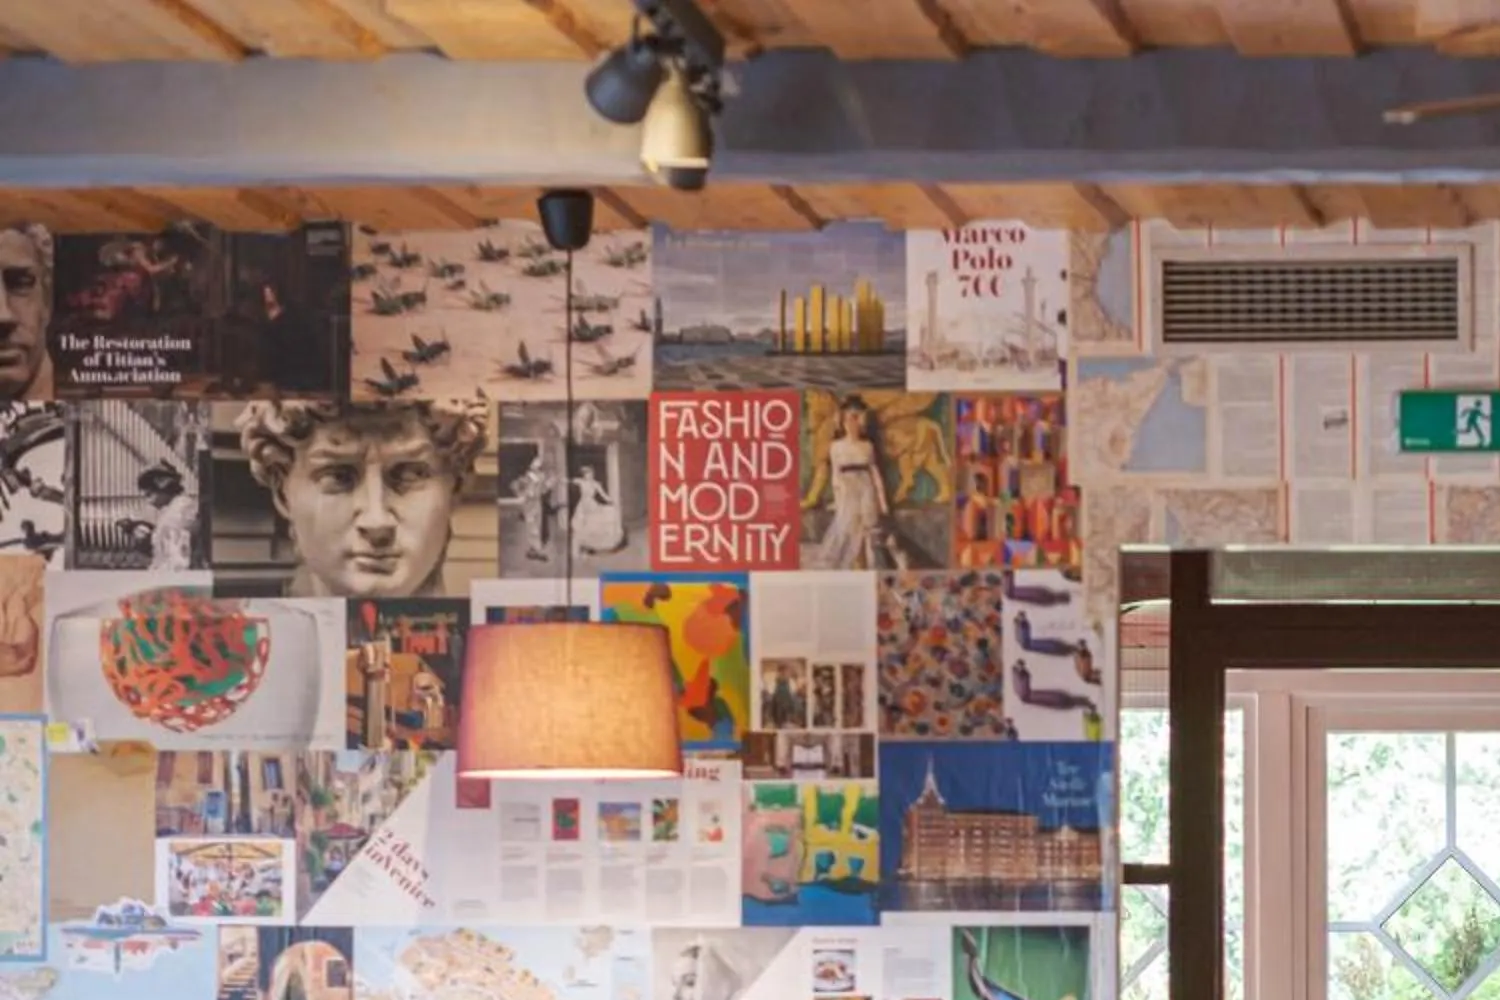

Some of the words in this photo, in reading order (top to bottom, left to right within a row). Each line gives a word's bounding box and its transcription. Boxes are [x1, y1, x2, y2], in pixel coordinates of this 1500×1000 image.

[952, 246, 1013, 270] Polo
[60, 334, 90, 349] The
[94, 335, 192, 350] Restoration
[83, 353, 100, 367] of
[660, 400, 793, 439] FASHIO
[660, 442, 686, 480] N
[704, 441, 793, 480] AND
[660, 482, 760, 521] MOD
